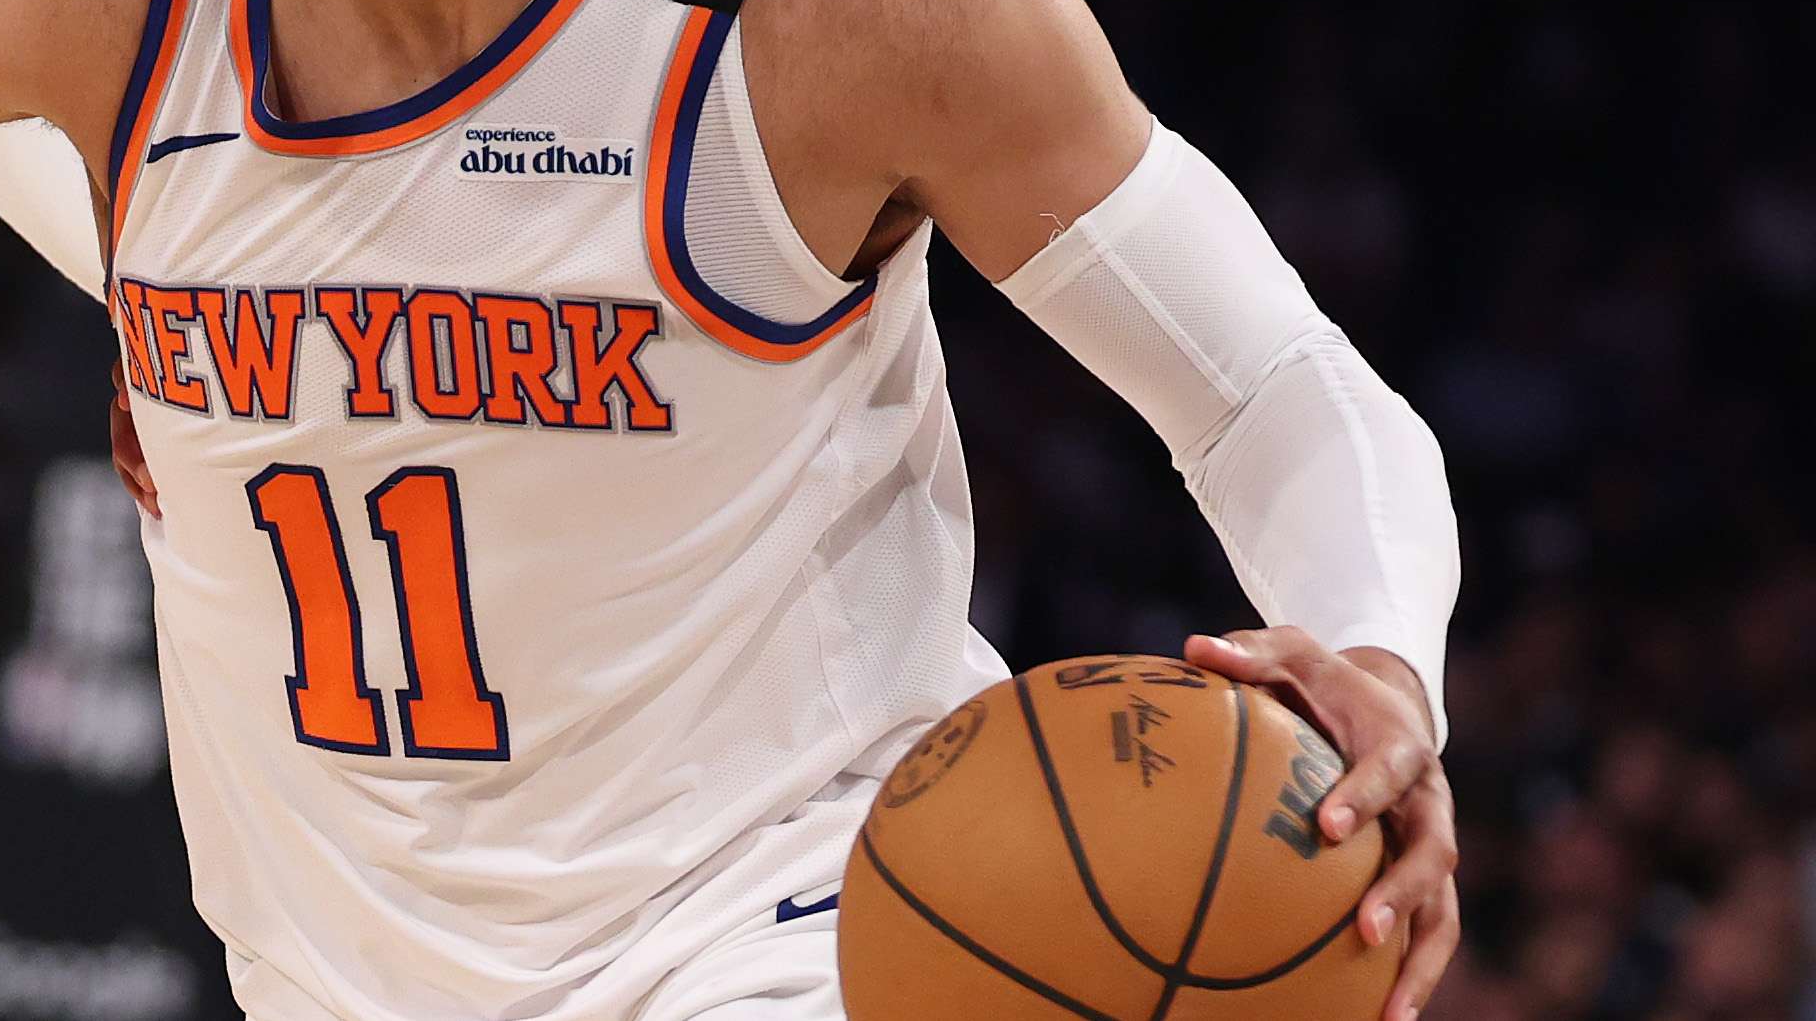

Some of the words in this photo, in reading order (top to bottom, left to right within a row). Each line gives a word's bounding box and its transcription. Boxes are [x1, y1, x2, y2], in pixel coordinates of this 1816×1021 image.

[460, 144, 526, 174] abu
[465, 127, 556, 144] experience
[116, 276, 312, 424] NEW
[312, 281, 677, 436] YORK
[245, 462, 511, 762] 11
